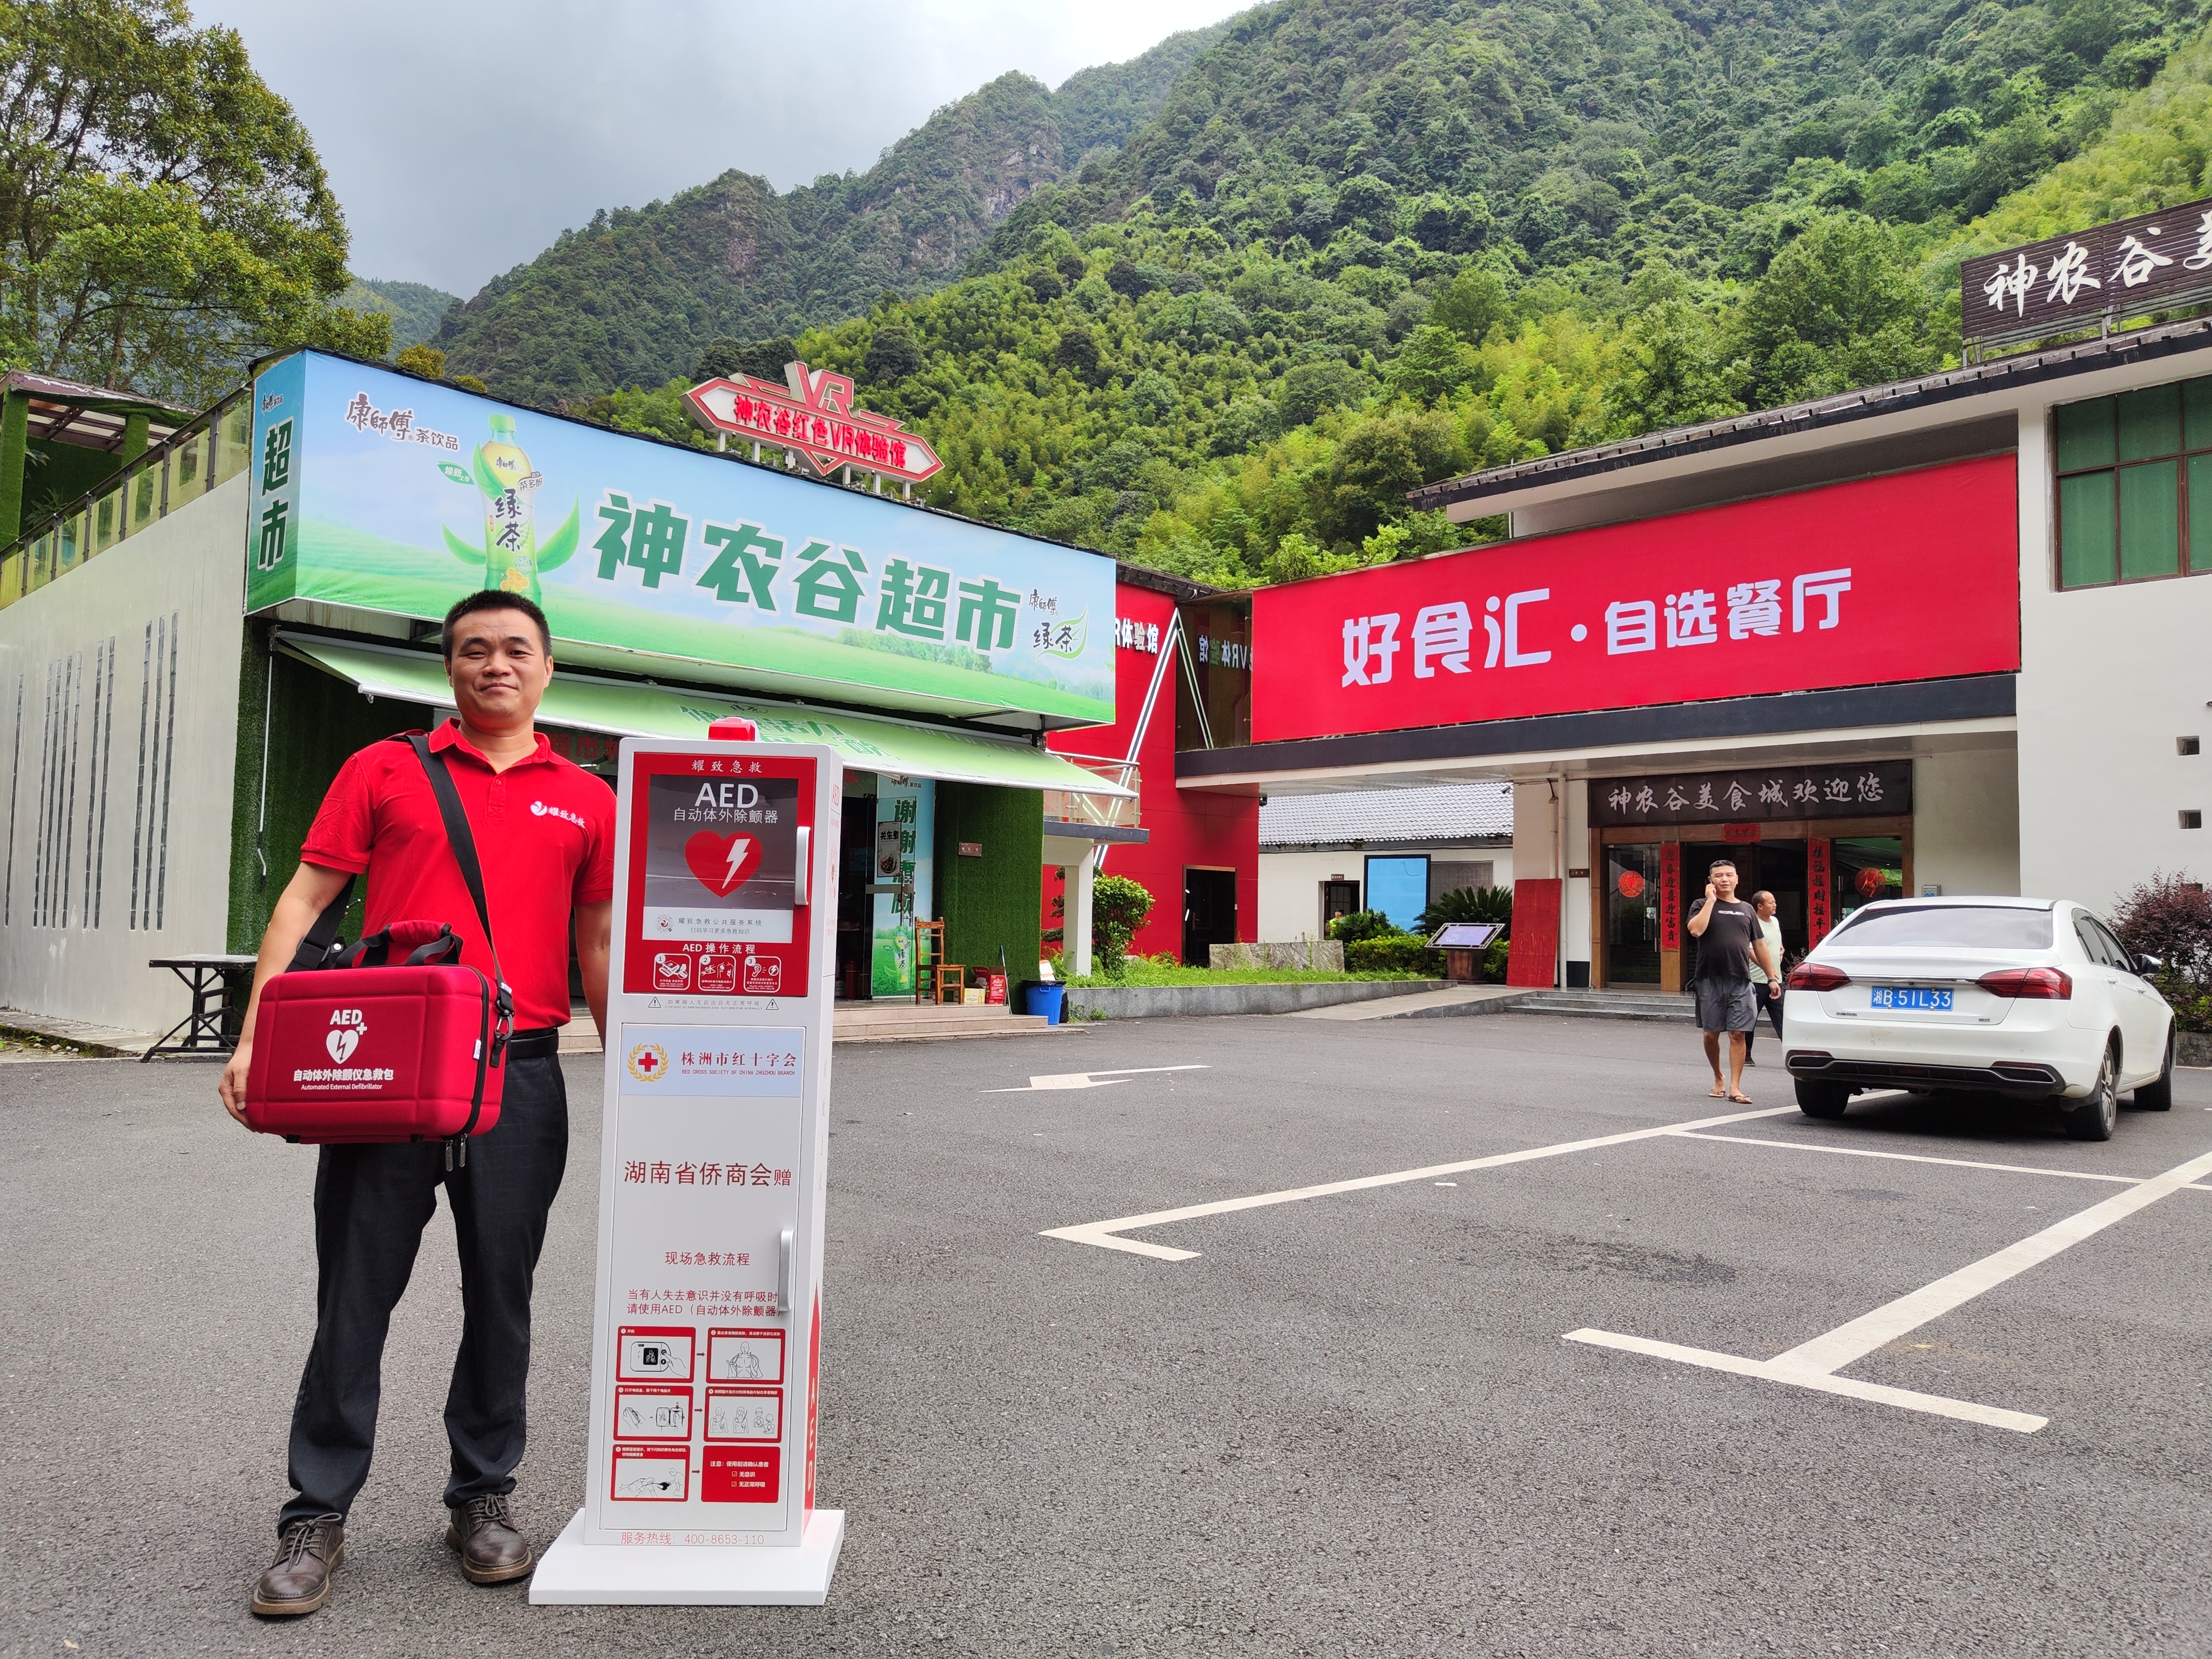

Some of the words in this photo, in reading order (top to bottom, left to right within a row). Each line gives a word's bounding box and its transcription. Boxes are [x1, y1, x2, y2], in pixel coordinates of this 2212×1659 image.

[415, 429, 458, 450] 茶饮品
[734, 394, 907, 468] 神农谷红色VR体验馆
[259, 420, 293, 569] 超市
[495, 488, 522, 552] 绿茶
[592, 493, 1022, 651] 神农谷超市
[1033, 622, 1073, 653] 绿茶
[691, 759, 763, 773] 耀致急救
[694, 782, 759, 808] AED
[1608, 772, 1885, 816] 神农谷美食城欢迎您
[673, 808, 779, 825] 自动体外除颤器
[678, 917, 763, 927] 耀致急救公共服务系统
[682, 943, 703, 952] AED
[705, 943, 756, 954] 操作流程
[329, 1009, 363, 1025] AED
[681, 1051, 797, 1067] 株洲市红十字会
[293, 1068, 394, 1082] 自动体外除颤仪急救包
[624, 1160, 792, 1187] 湖南省侨商会赠
[665, 1251, 751, 1266] 现场急救流程
[628, 1288, 779, 1303] 当有人失去意识并没有呼吸时
[684, 1534, 765, 1545] 400-8653-110
